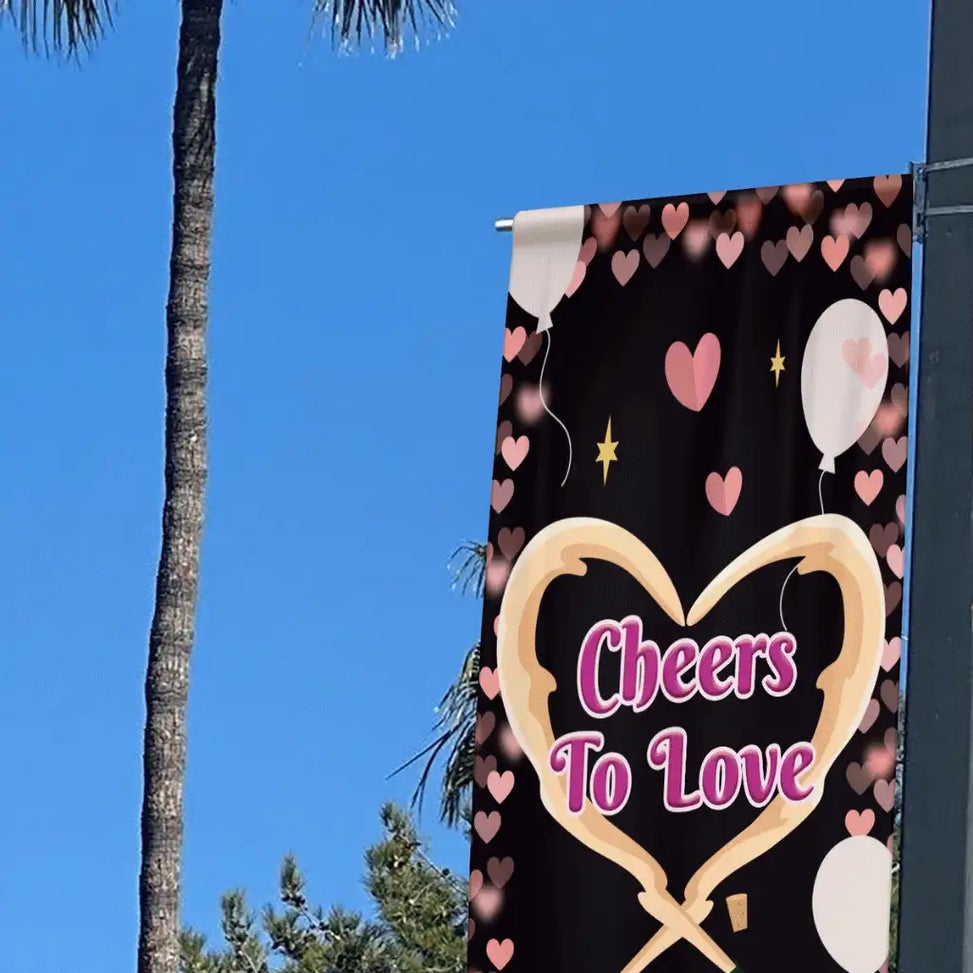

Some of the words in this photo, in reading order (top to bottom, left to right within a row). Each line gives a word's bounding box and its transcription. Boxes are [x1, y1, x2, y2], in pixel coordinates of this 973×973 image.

[577, 614, 798, 719] Cheers
[550, 730, 632, 817] To
[647, 726, 816, 812] Love
